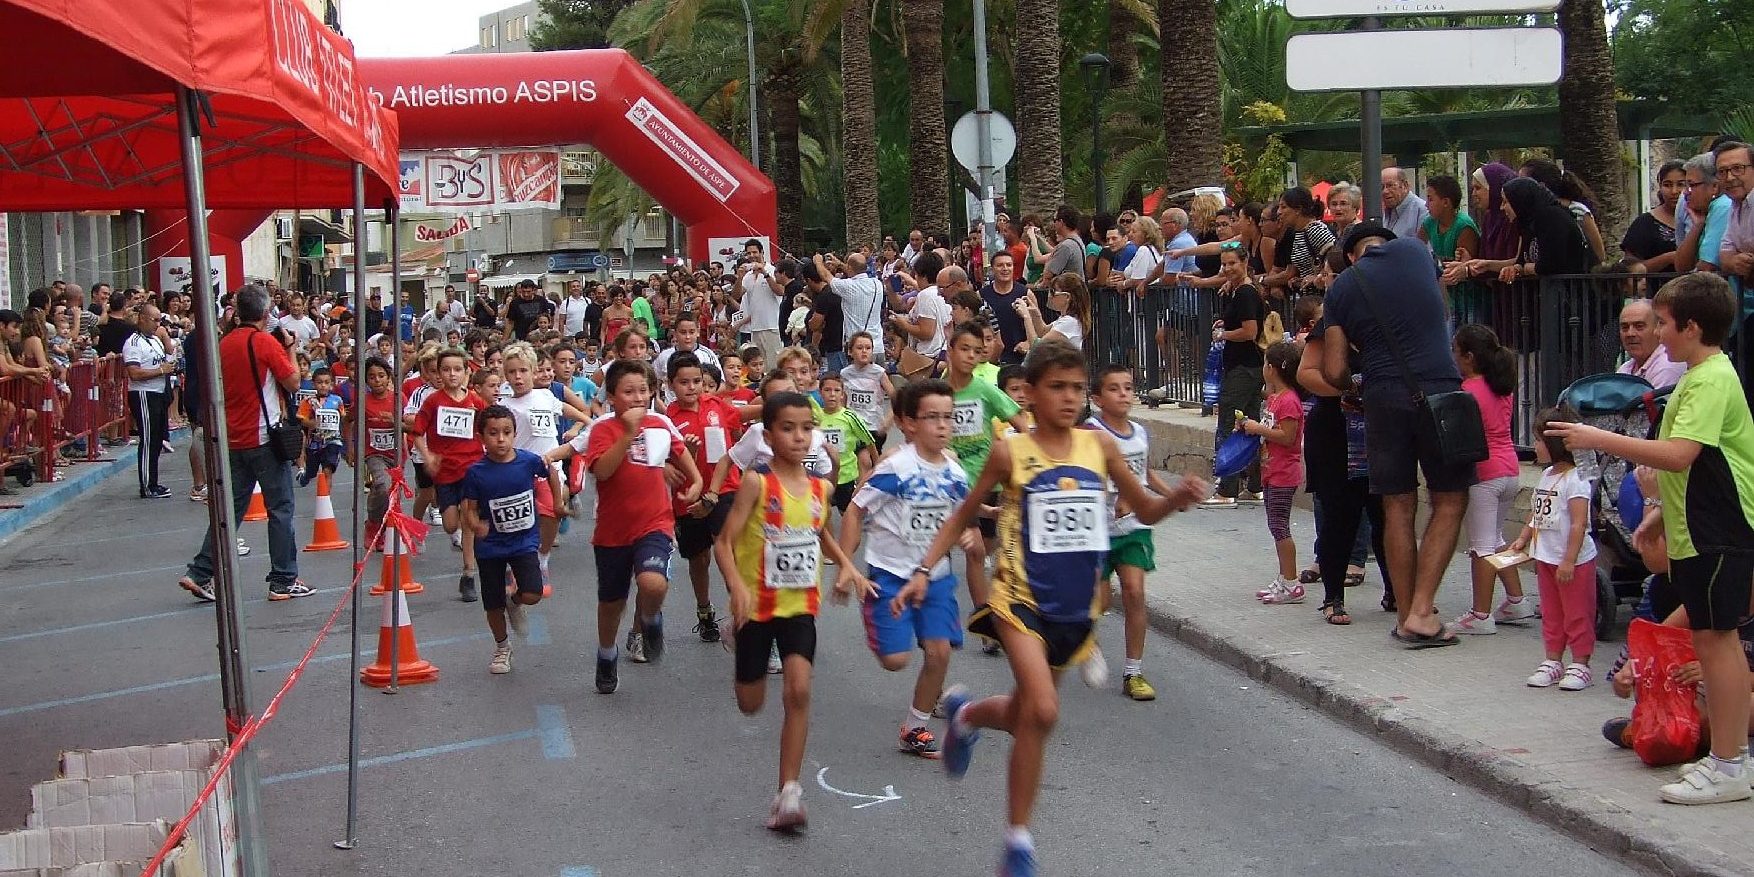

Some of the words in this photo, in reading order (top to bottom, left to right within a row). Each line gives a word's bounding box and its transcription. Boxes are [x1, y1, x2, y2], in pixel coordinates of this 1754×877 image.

[390, 83, 508, 108] Atletismo
[513, 79, 597, 104] ASPIS
[648, 120, 701, 167] AYUNTAMIENTO
[699, 164, 713, 177] DE
[708, 173, 727, 190] ASPE
[851, 393, 872, 404] 663
[443, 414, 469, 429] 471
[529, 414, 552, 428] 673
[954, 409, 975, 425] 62
[497, 502, 531, 522] 1373
[911, 512, 946, 531] 626
[1043, 508, 1096, 533] 980
